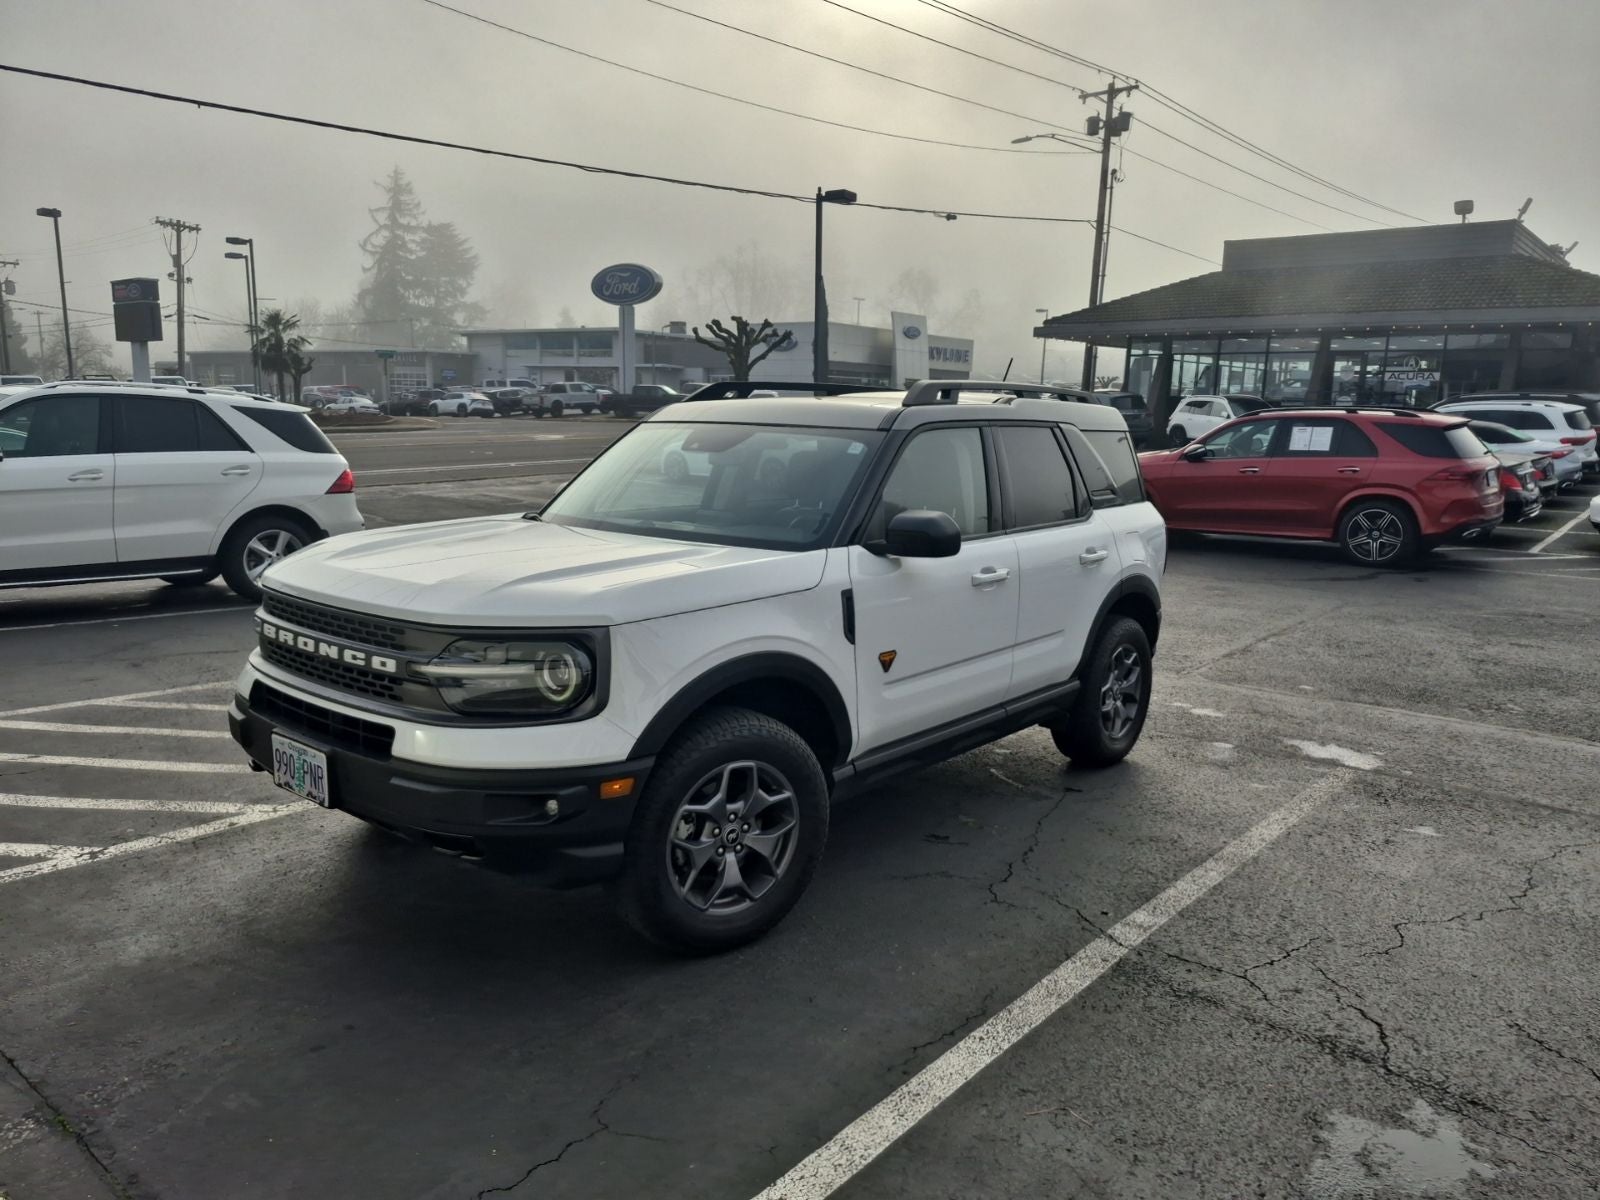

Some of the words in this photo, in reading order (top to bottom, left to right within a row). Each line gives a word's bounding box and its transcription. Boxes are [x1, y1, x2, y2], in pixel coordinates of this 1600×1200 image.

[603, 271, 640, 296] Ford
[928, 346, 970, 363] KYLINE
[1388, 372, 1435, 381] ACURA
[263, 622, 397, 673] BRONCO
[275, 748, 295, 780] 990
[303, 758, 324, 793] PNR
